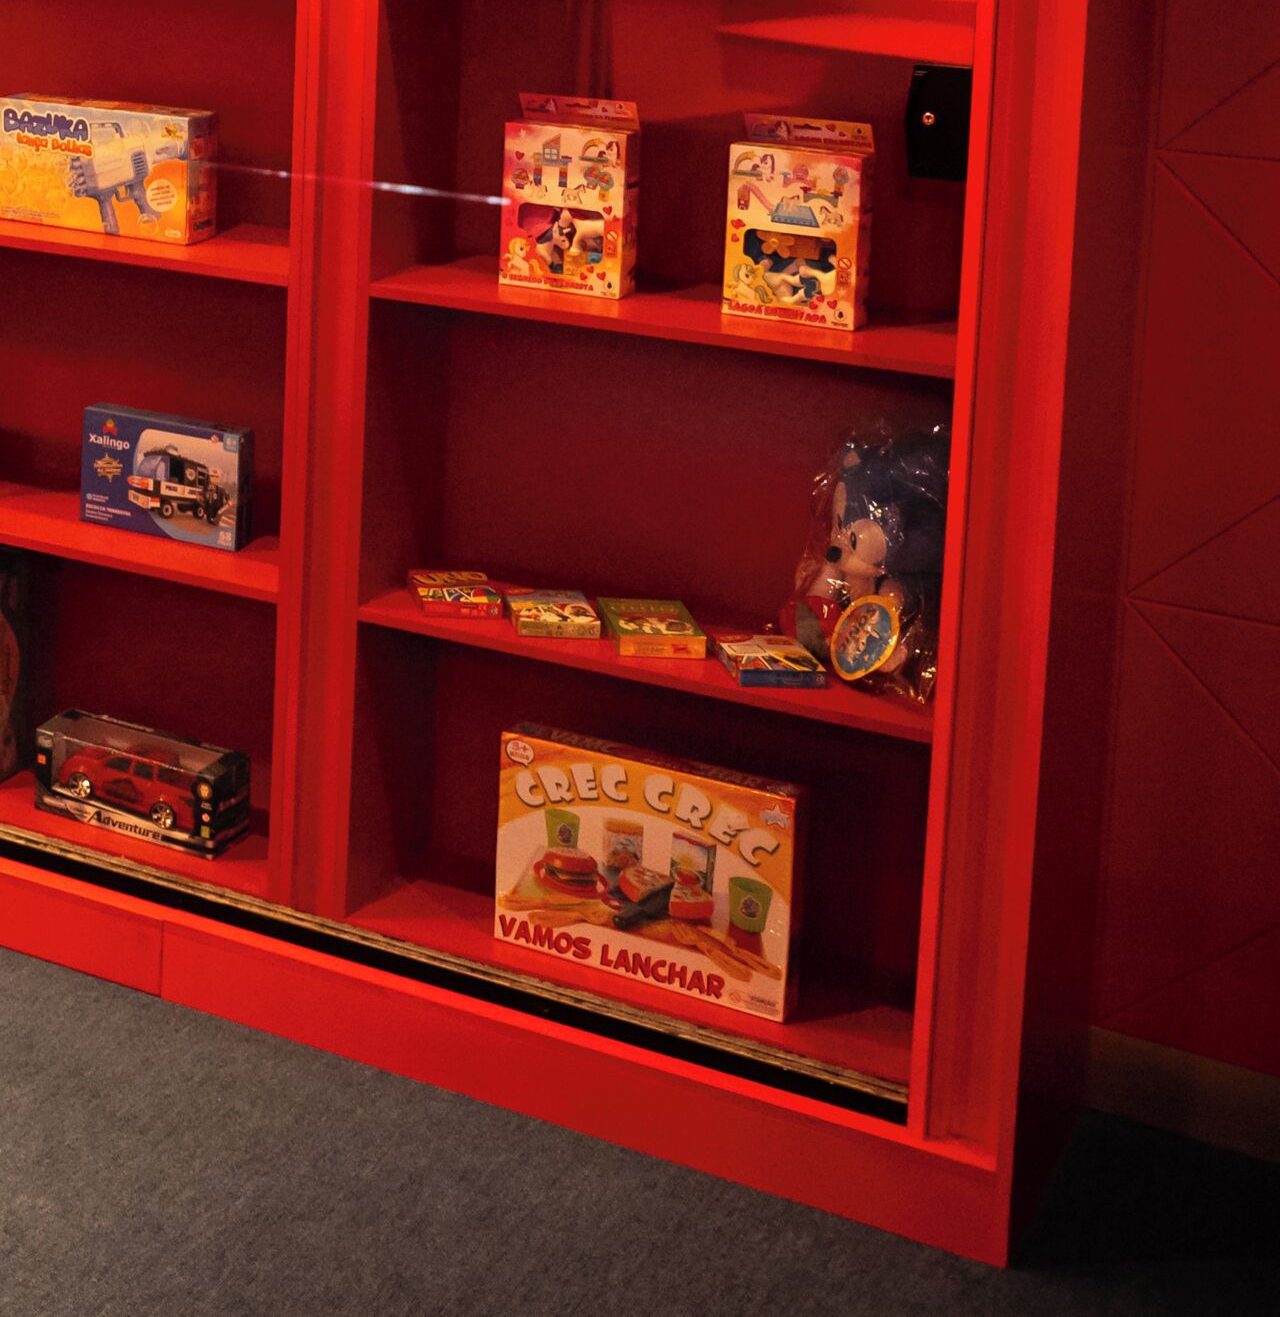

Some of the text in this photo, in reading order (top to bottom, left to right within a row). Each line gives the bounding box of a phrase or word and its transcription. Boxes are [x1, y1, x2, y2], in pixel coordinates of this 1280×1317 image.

[3, 108, 90, 142] BAZUKA
[89, 433, 131, 450] Xalingo
[86, 809, 161, 841] Adventure
[515, 762, 781, 867] CREC CREC
[498, 913, 726, 1001] VAMOS LANCHAR
